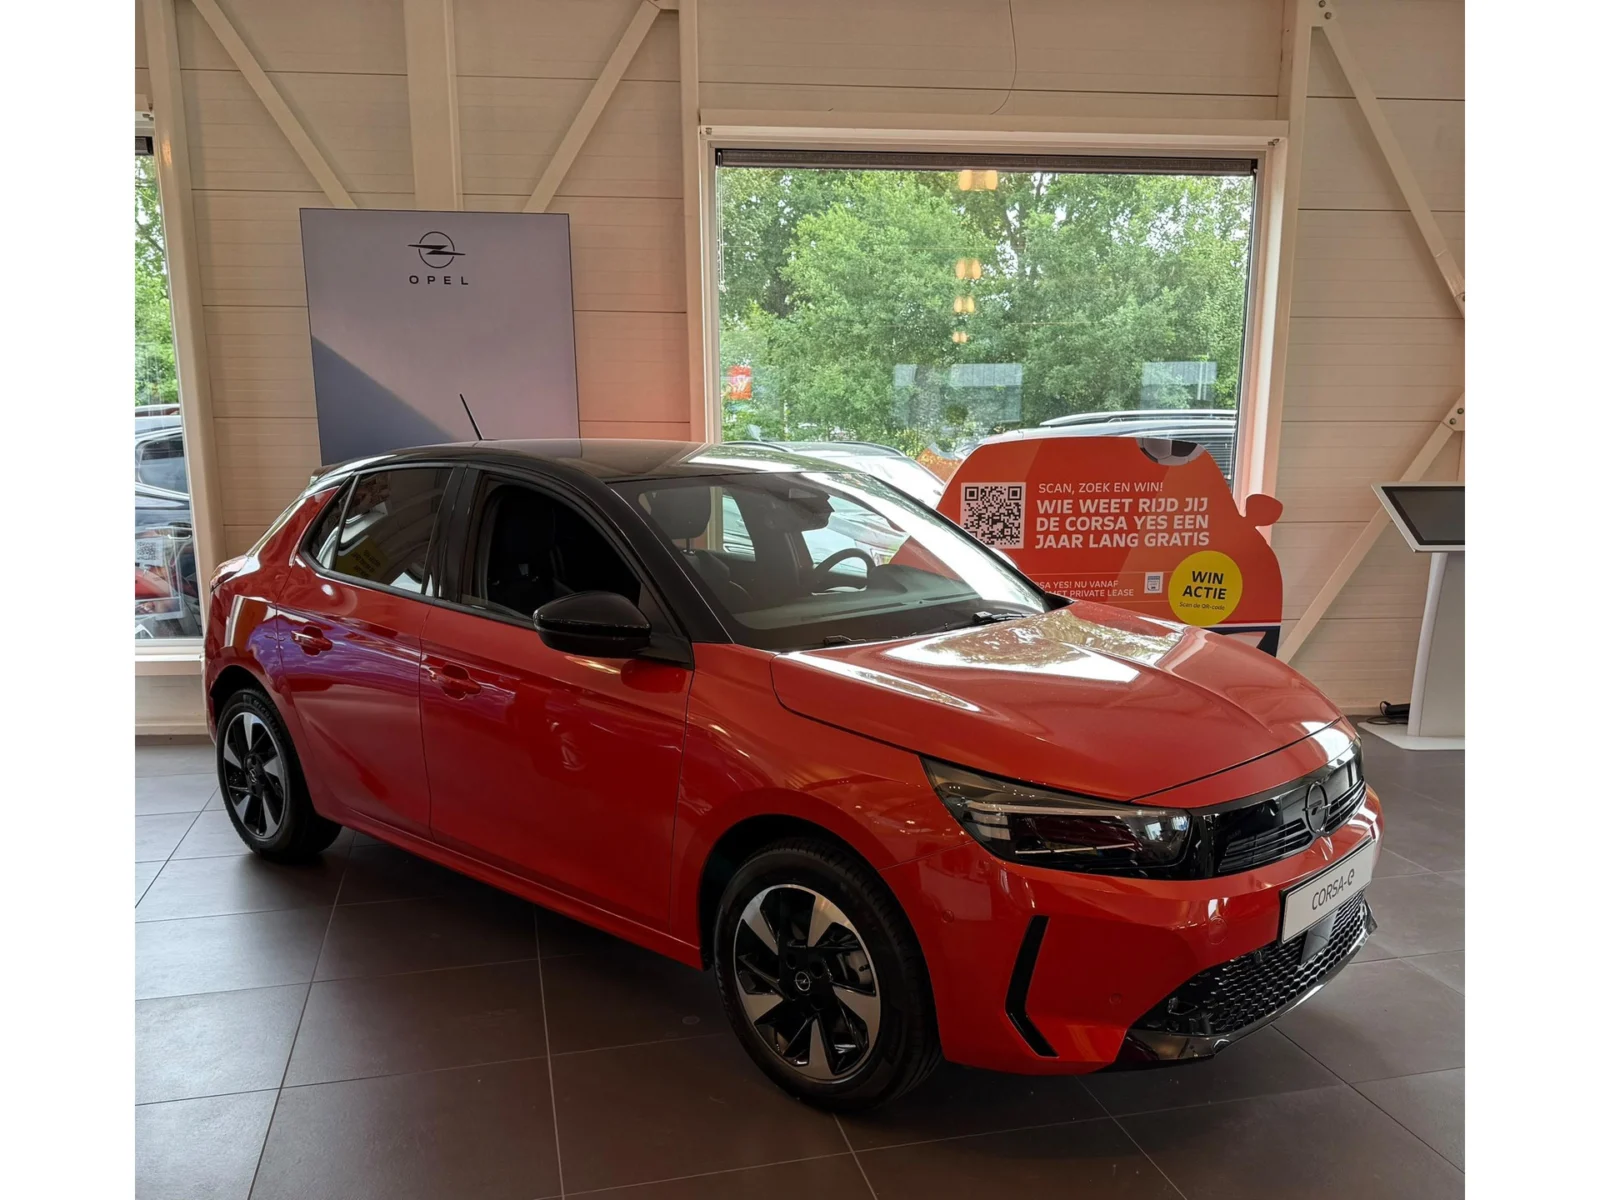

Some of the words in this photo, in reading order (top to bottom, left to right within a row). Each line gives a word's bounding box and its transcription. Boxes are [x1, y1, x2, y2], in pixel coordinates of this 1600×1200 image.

[408, 275, 469, 286] OPEL
[1038, 483, 1075, 495] SCAN,
[1078, 482, 1111, 493] ZOEK
[1113, 482, 1130, 493] EN
[1133, 481, 1164, 492] WIN!
[1036, 499, 1073, 514] WIE
[1078, 498, 1133, 514] WEET
[1138, 498, 1179, 513] RIJD
[1183, 497, 1208, 512] JIJ
[1036, 517, 1060, 532] DE
[1065, 516, 1128, 531] CORSA
[1133, 515, 1168, 530] YES
[1173, 514, 1209, 529] EEN
[1035, 534, 1084, 549] JAAR
[1089, 533, 1139, 548] LANG
[1144, 532, 1210, 547] GRATIS
[1053, 580, 1072, 589] YES!
[1074, 580, 1088, 589] NU
[1089, 580, 1119, 588] VANAF
[1192, 570, 1224, 585] WIN
[1069, 589, 1105, 597] PRIVATE
[1107, 588, 1135, 597] LEASE
[1182, 585, 1227, 600] ACTIE
[1311, 868, 1355, 911] CORSA-e
